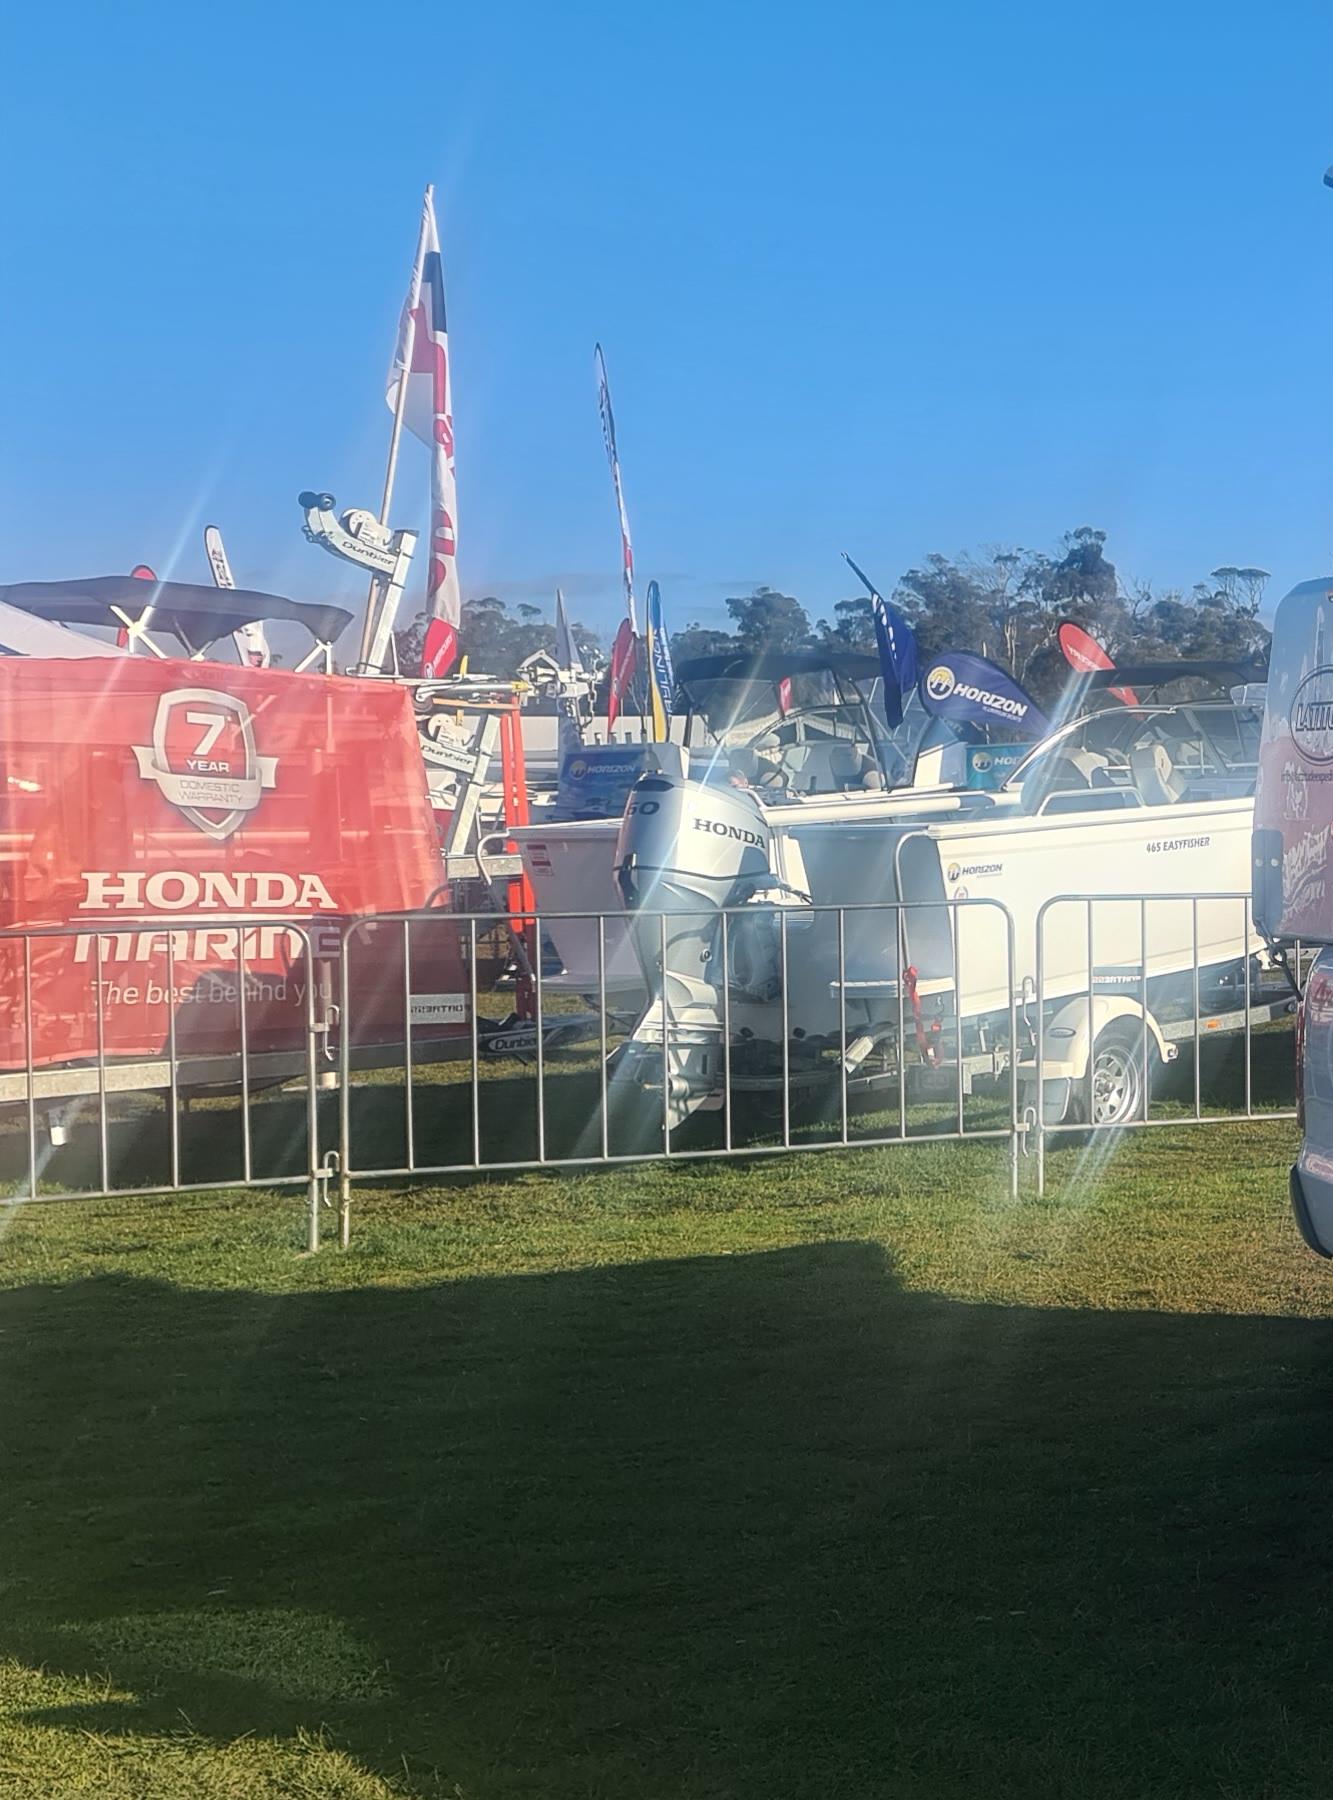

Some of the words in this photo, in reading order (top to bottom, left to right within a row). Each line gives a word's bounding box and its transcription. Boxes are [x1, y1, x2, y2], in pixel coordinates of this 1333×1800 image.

[342, 541, 394, 565] Dunbier
[953, 683, 1028, 717] HORIZON
[186, 711, 226, 755] 7
[186, 759, 230, 773] YEAR
[179, 791, 243, 804] WARRANTY
[180, 780, 240, 793] DOMESTIC
[692, 817, 766, 849] HONDA
[1146, 841, 1161, 853] 465
[1162, 836, 1211, 852] EASYFISHER
[78, 871, 339, 909] HONDA
[146, 979, 202, 1005] best
[495, 1034, 538, 1051] Dunbie
